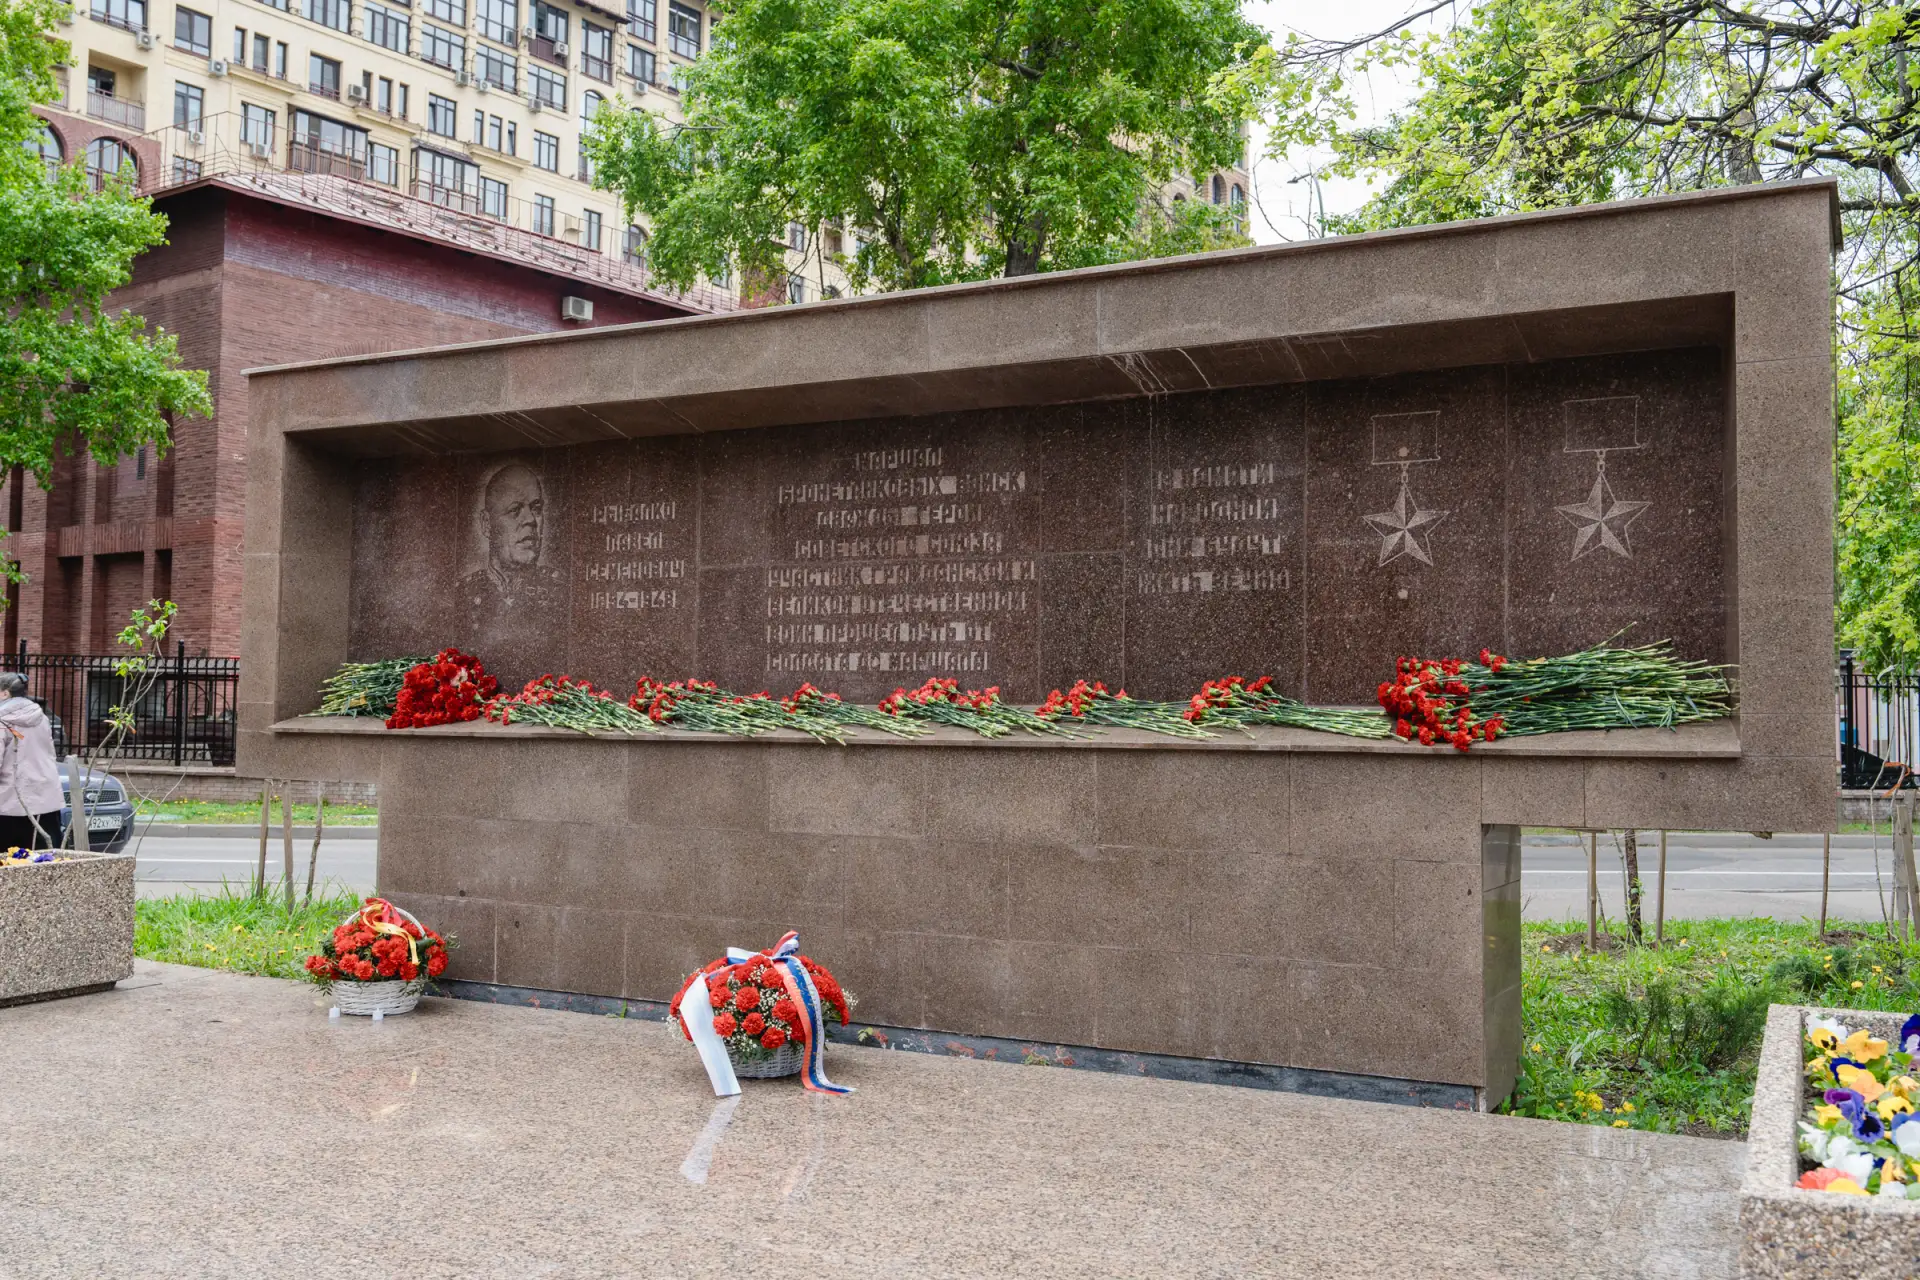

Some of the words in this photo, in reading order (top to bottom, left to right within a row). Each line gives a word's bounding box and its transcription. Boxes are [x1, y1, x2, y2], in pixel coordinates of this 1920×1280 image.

[854, 448, 942, 470] МАРШАЛ
[778, 476, 945, 503] БРОНЕТАНКОВЫХ
[956, 471, 1026, 495] ВОЙСК
[593, 502, 676, 522] РЫБАЛКО
[816, 506, 902, 529] ДВАЖДЫ
[917, 503, 982, 525] ГЕРОЙ
[605, 532, 663, 552] ПАВЕЛ
[794, 538, 916, 558] СОВЕТСКОГО
[768, 565, 861, 588] УЧАСТНИК
[872, 560, 1012, 585] ГРАЖДАНСКОЙ
[591, 590, 677, 609] 1894-1948
[768, 596, 852, 617] ВЕЛИКОЙ
[860, 591, 1026, 613] ОТЕЧЕСТВЕННОЙ
